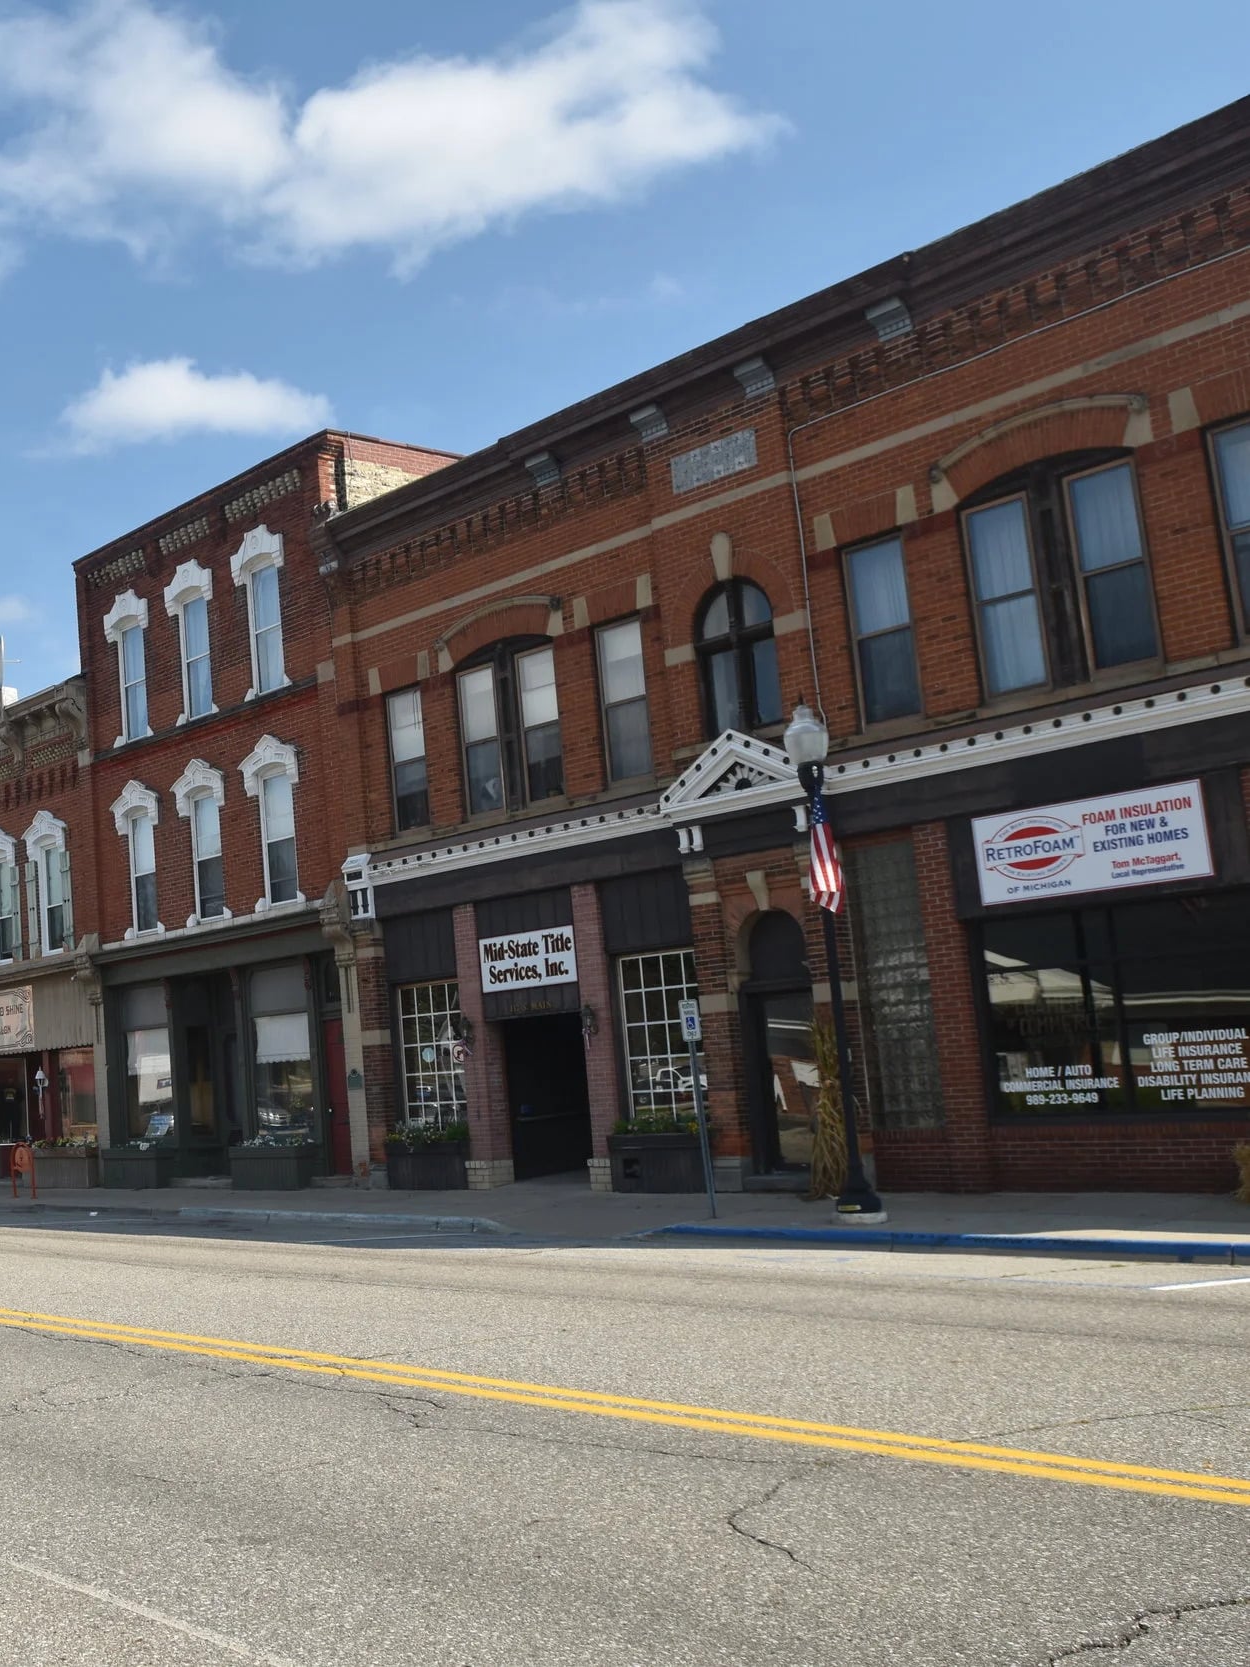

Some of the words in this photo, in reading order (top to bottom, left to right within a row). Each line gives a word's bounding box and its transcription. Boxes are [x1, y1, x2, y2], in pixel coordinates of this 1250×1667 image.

[1081, 809, 1116, 825] FOAM
[1119, 796, 1192, 819] INSULATION
[1104, 822, 1127, 836] FOR
[1130, 818, 1156, 832] NEW
[1159, 816, 1168, 828] &
[1093, 835, 1144, 852] EXISTING
[1147, 828, 1189, 844] HOMES
[1111, 860, 1130, 869] Tom
[1132, 852, 1182, 866] McTaggart,
[1111, 870, 1130, 879] Local
[1131, 863, 1185, 876] Representative
[1007, 886, 1020, 894] OF
[1023, 880, 1072, 891] MICHIGAN
[483, 938, 539, 963] Mid-State
[541, 931, 572, 954] Title
[489, 962, 542, 984] Services,
[544, 958, 569, 977] Inc.
[5, 1003, 24, 1016] SHINE
[1143, 1028, 1249, 1045] GROUP/INDIVIDUAL
[1151, 1047, 1176, 1058] LIFE
[1178, 1043, 1243, 1057] INSURANCE
[1025, 1067, 1056, 1078] HOME
[1057, 1066, 1063, 1077] /
[1065, 1064, 1092, 1076] AUTO
[1150, 1061, 1180, 1073] LONG
[1182, 1059, 1214, 1071] TERM
[1217, 1057, 1248, 1069] CARE
[1004, 1080, 1064, 1092] COMMERCIAL
[1065, 1077, 1120, 1090] INSURANCE
[1137, 1074, 1197, 1087] DISABILITY
[1025, 1092, 1099, 1105] 989-233-9649
[1161, 1089, 1185, 1100] LIFE
[1187, 1087, 1245, 1099] PLANNING
